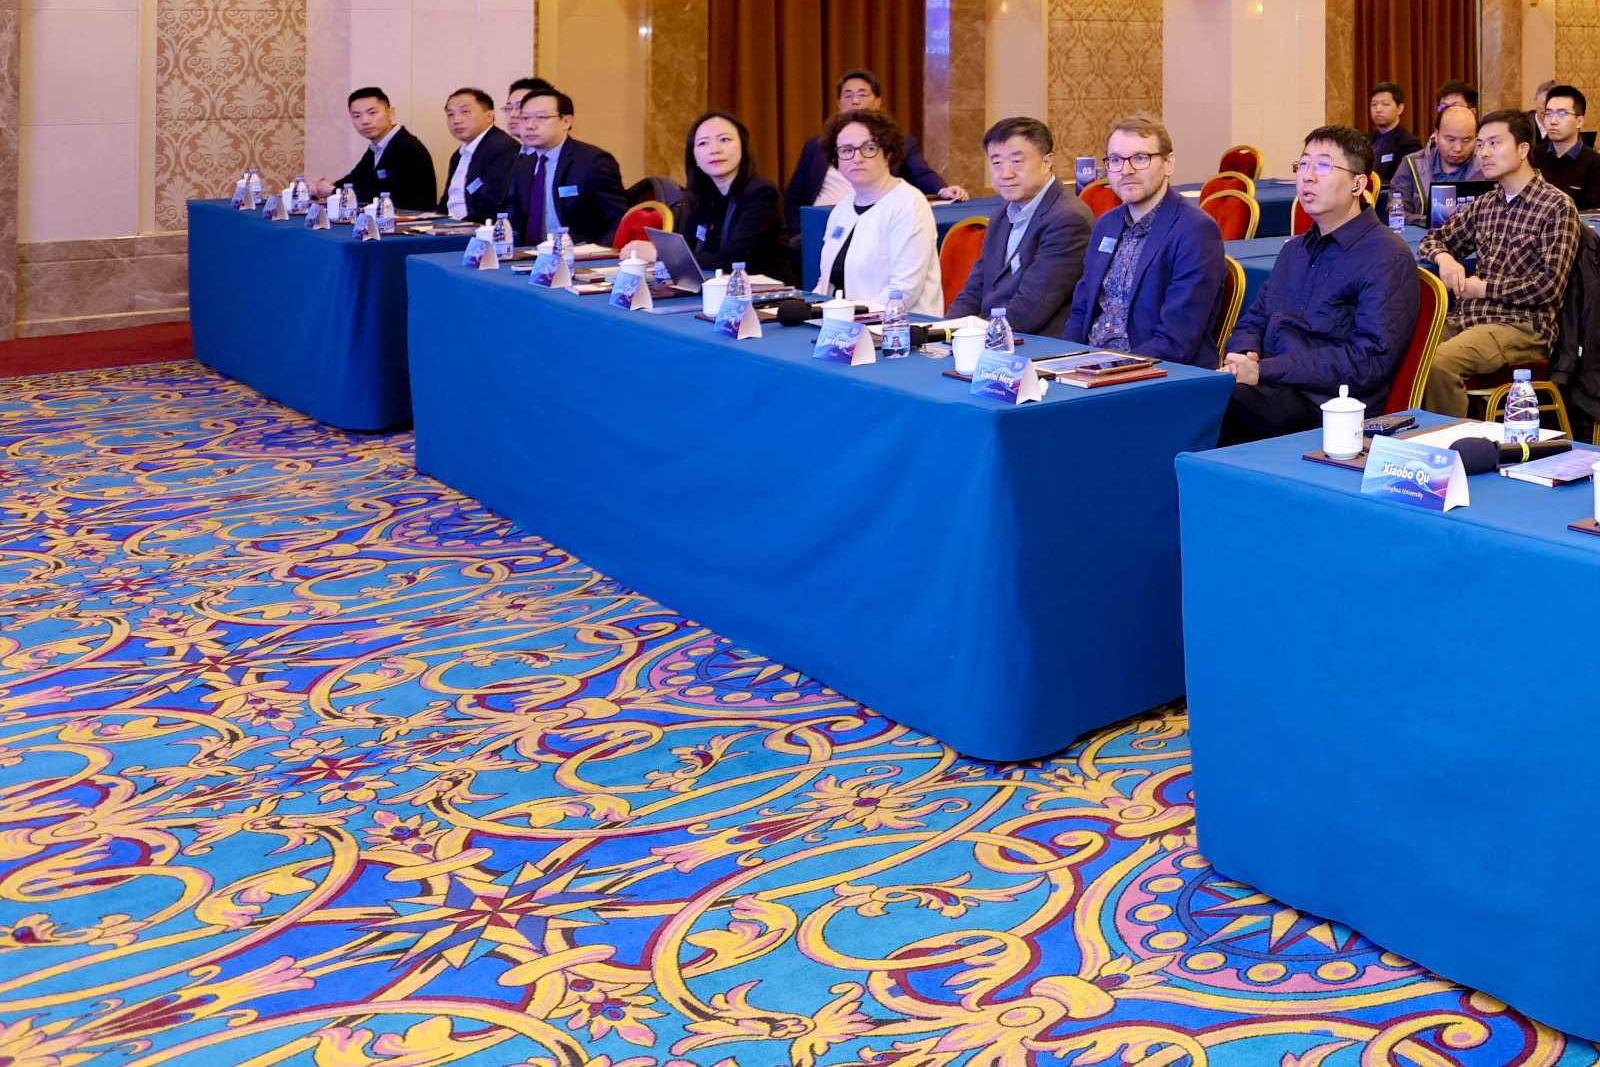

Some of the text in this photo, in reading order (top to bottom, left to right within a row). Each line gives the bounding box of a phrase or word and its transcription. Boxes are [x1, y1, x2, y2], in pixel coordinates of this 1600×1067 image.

[1445, 197, 1454, 207] 02
[1383, 462, 1430, 485] Xiaobo Qu
